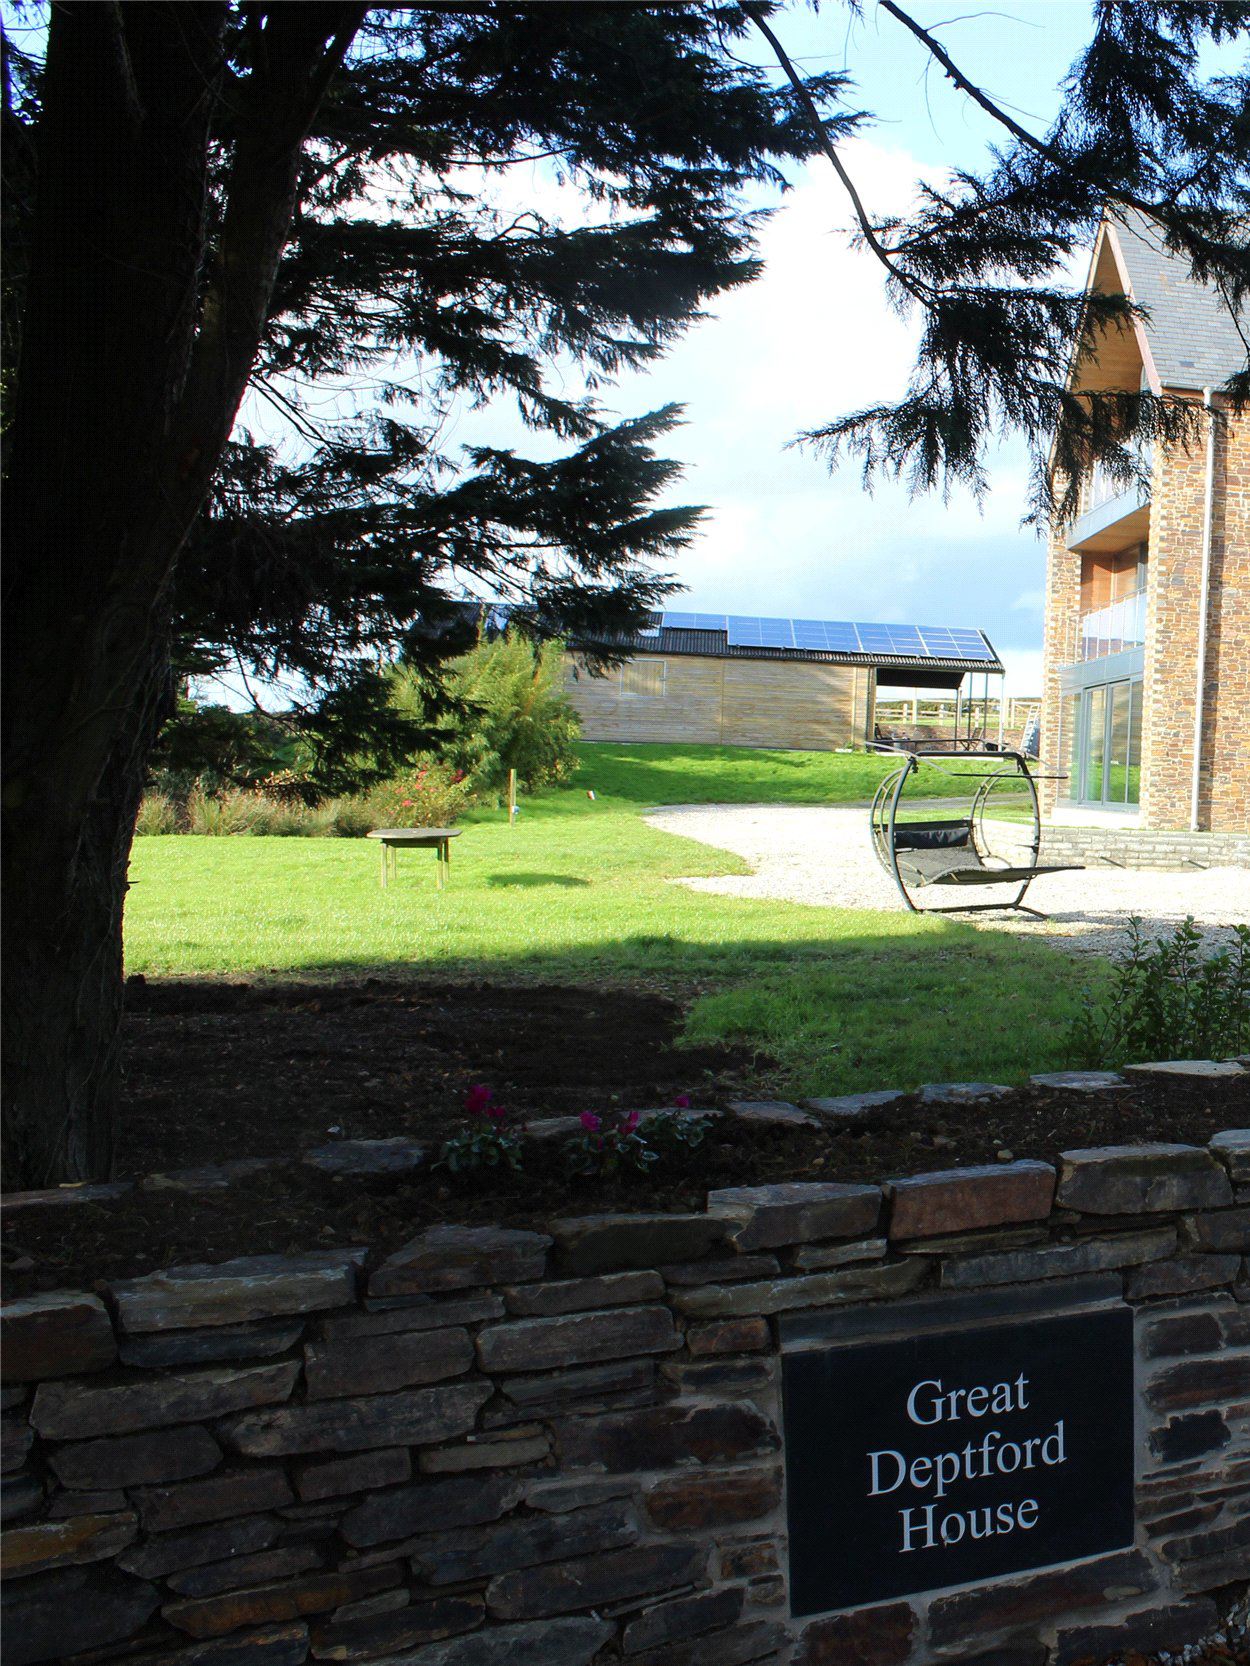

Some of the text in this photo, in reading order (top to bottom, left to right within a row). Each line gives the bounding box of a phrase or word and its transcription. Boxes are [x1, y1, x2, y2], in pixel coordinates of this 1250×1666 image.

[906, 1372, 1030, 1426] Great
[866, 1419, 1067, 1498] Deptford
[898, 1499, 1039, 1553] House
